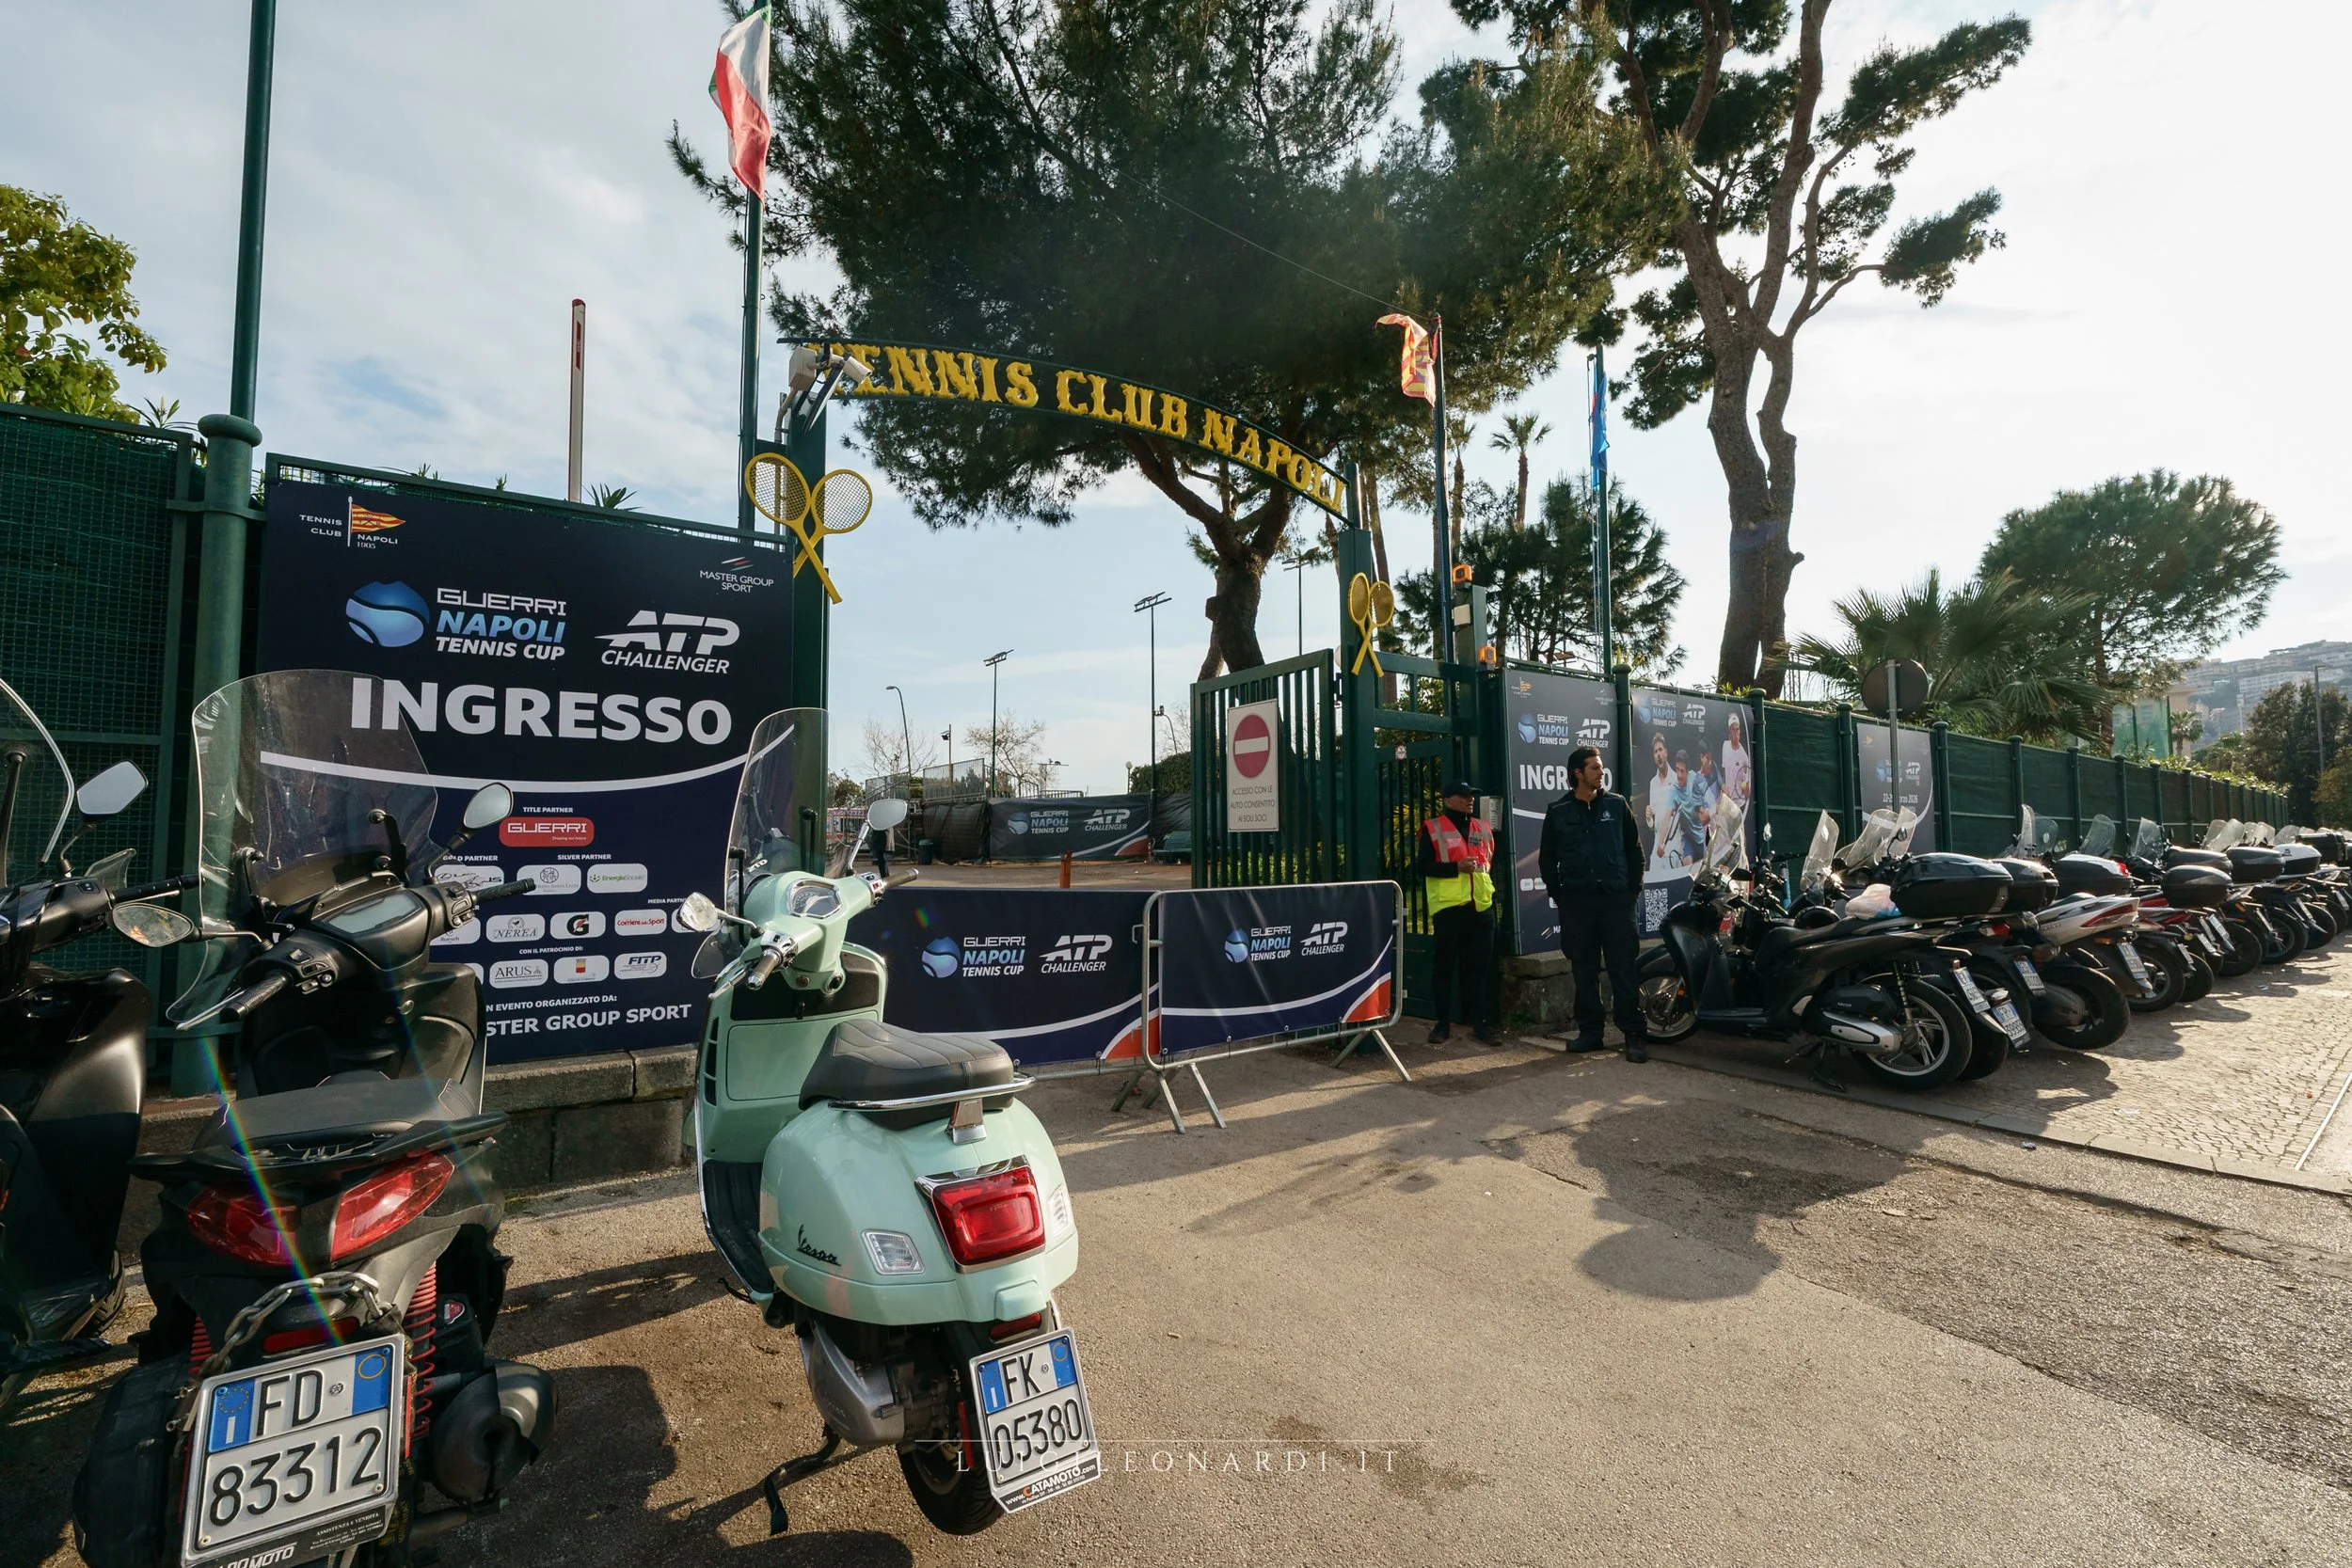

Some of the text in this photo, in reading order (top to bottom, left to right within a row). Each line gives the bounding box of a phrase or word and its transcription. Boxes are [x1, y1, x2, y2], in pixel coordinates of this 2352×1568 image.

[1056, 369, 1189, 440] CLUB
[1199, 407, 1348, 514] NAPOLI
[299, 514, 342, 527] TENNIS
[310, 528, 398, 545] CLUB NAPOLI
[699, 570, 774, 587] MASTER GROUP
[722, 581, 753, 594] SPORT
[437, 587, 566, 616] GUERRI
[436, 610, 566, 643] NAPOLI
[594, 610, 740, 656] ATP
[436, 636, 565, 660] TENNIS CUP
[601, 649, 730, 674] CHALLENGER
[351, 677, 733, 746] INGRESSO
[1652, 706, 1677, 720] NAPOLI
[1682, 703, 1707, 720] ATP
[1538, 724, 1568, 736] NAPOLI
[1575, 718, 1611, 739] ATP
[1538, 736, 1569, 746] TENNIS CUP
[1577, 738, 1609, 749] CHALLENGER
[1268, 784, 1273, 793] LE
[1031, 817, 1069, 828] NAPOLI
[1083, 808, 1131, 824] ATP
[507, 822, 587, 833] GUERRI
[496, 928, 537, 939] NEREA
[1250, 926, 1292, 937] GUERRI
[1299, 922, 1348, 946] ATP
[963, 936, 1026, 947] GUERRI
[1039, 934, 1113, 962] ATP
[1250, 937, 1291, 951] NAPOLI
[962, 949, 1025, 965] NAPOLI
[1250, 949, 1291, 961] TENNIS CUP
[1301, 943, 1344, 957] CHALLENGER
[628, 955, 661, 965] FITP
[1041, 961, 1106, 974] CHALLENGER
[495, 966, 532, 978] ARUS
[962, 965, 1025, 977] TENNIS CUP
[495, 1001, 533, 1011] EVENTO
[534, 995, 600, 1007] ORGANIZZATO
[486, 1004, 692, 1037] STER GROUP SPORT
[796, 1223, 842, 1267] Vespa
[1002, 1353, 1041, 1403] FK
[256, 1370, 324, 1437] FD
[993, 1399, 1083, 1468] 05380
[209, 1427, 383, 1527] 83312
